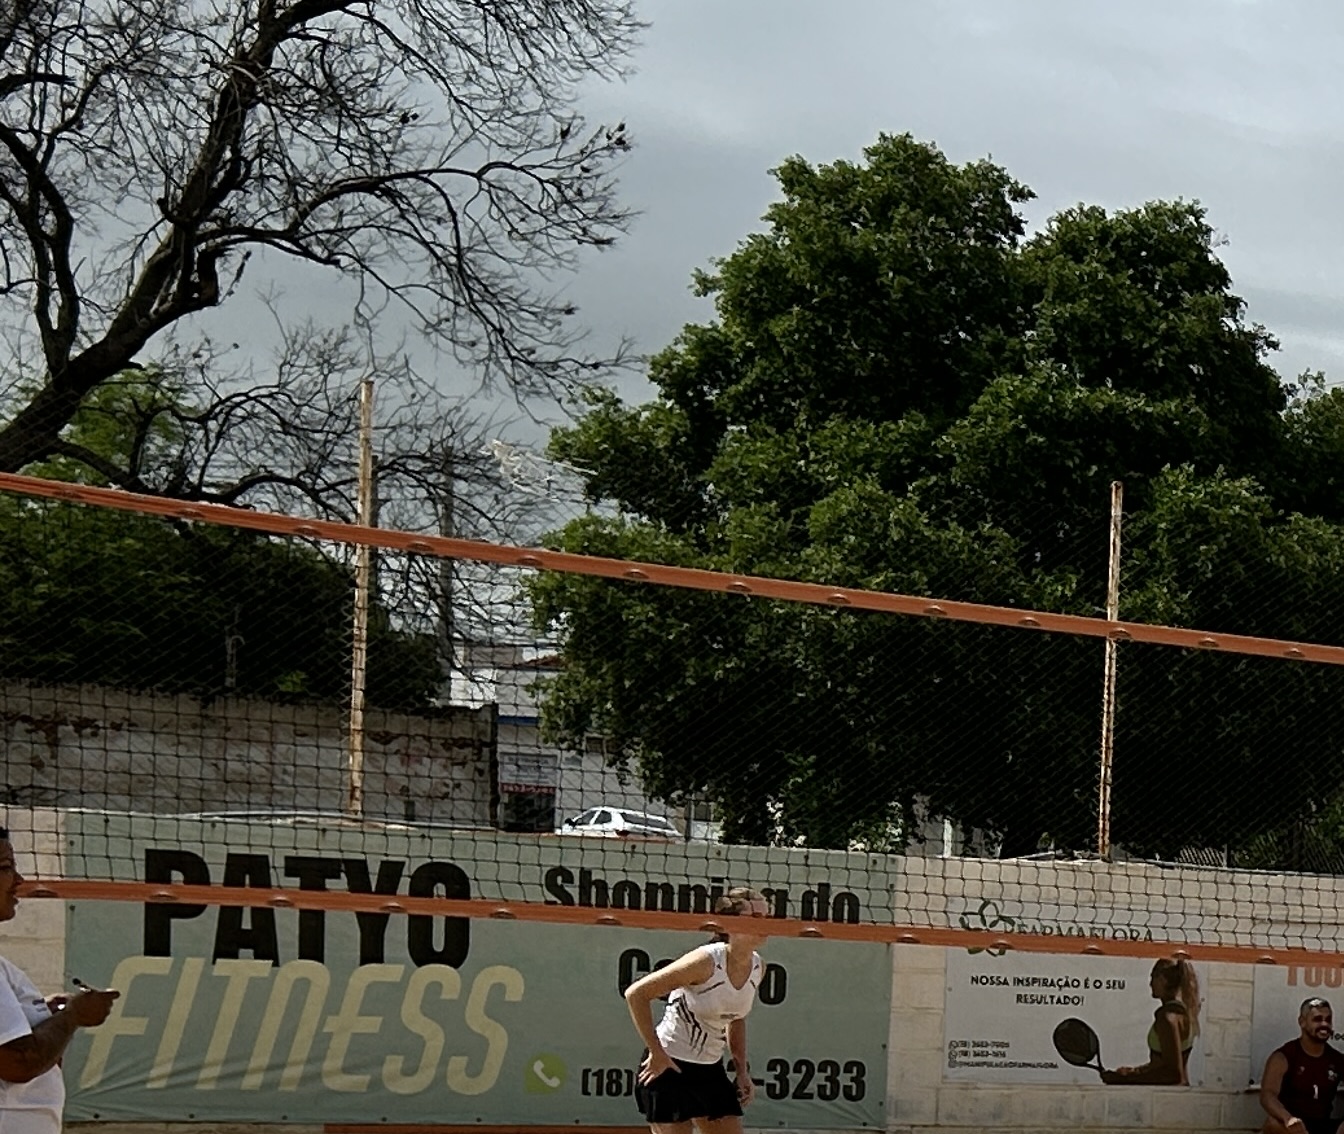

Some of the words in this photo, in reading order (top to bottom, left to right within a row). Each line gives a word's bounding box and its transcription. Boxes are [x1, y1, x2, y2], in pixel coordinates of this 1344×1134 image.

[143, 848, 471, 969] PATYO
[801, 882, 861, 923] do
[970, 975, 1009, 987] NOSSA
[1013, 976, 1080, 990] INSPIRAÇÃO
[1084, 977, 1090, 989] É
[1093, 979, 1102, 989] O
[1106, 979, 1126, 990] SEU
[1016, 994, 1084, 1006] RESULTADO!
[581, 1068, 634, 1097] (18)
